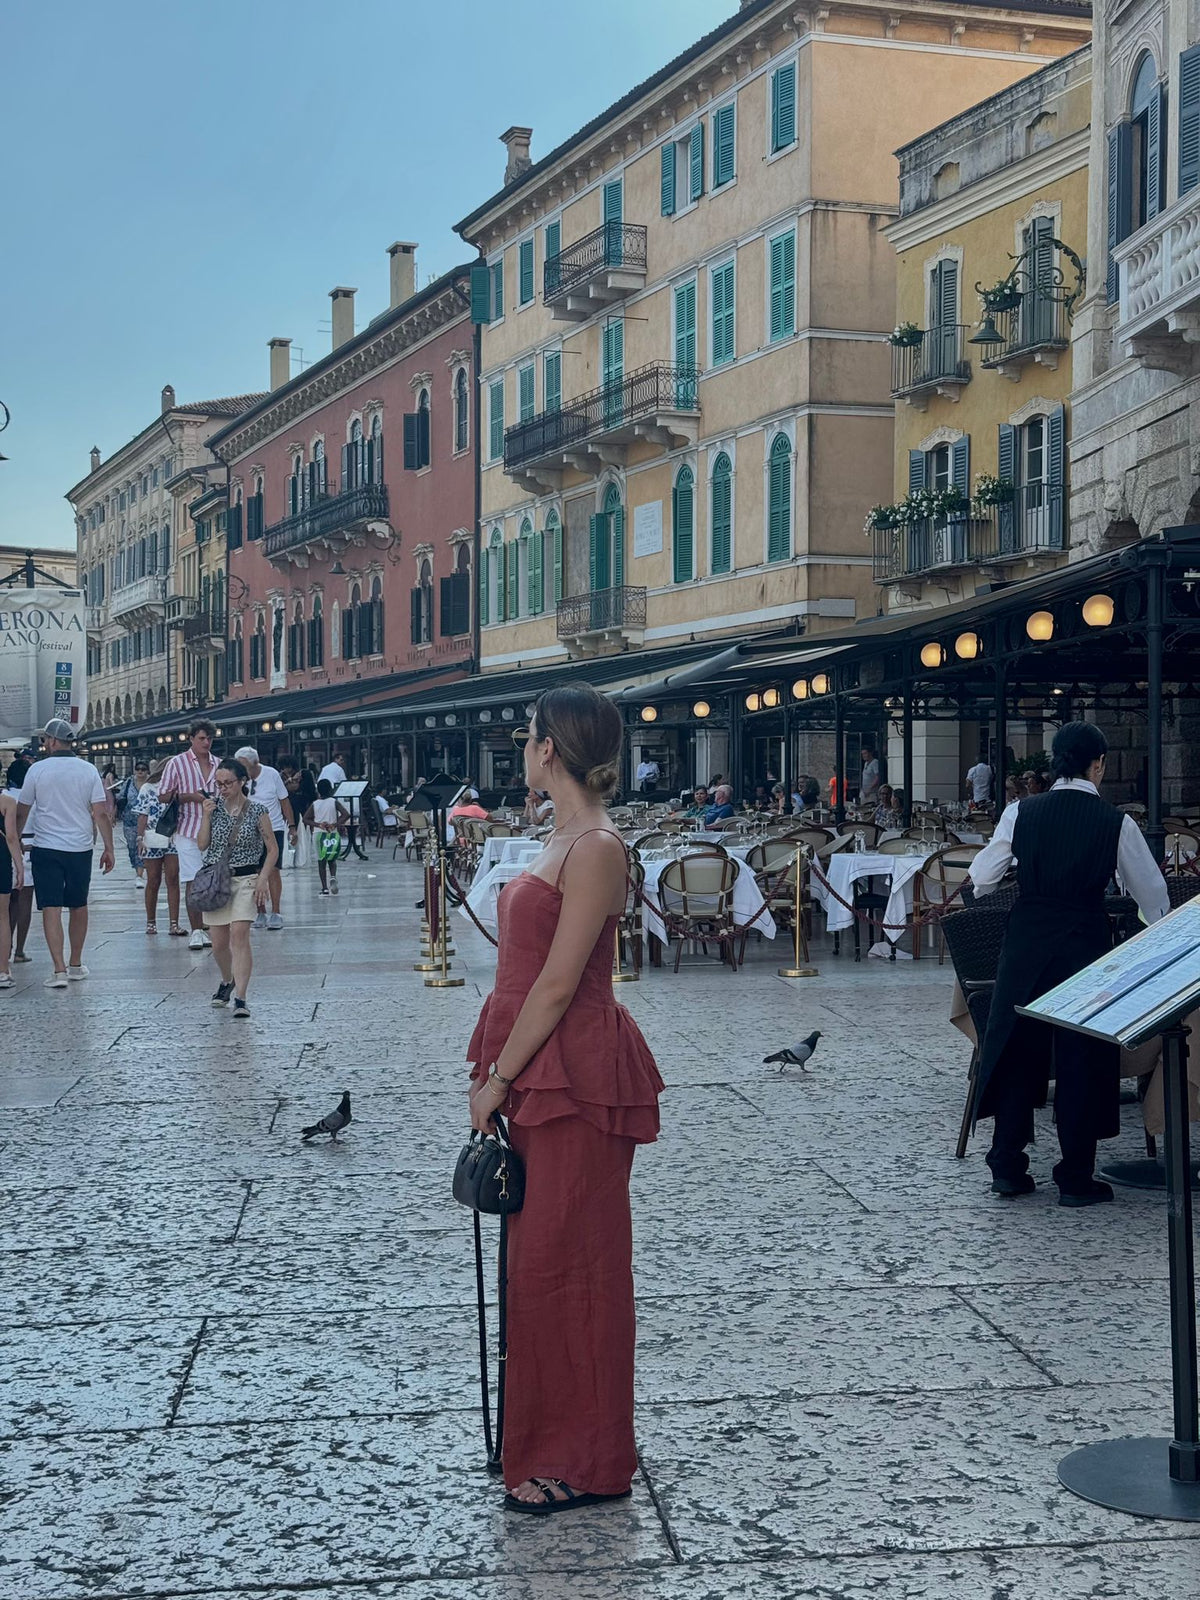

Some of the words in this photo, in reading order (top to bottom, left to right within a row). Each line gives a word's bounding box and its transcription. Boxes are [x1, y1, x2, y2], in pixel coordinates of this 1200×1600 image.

[0, 609, 83, 632] ERONA
[0, 629, 40, 648] ANO
[38, 639, 73, 652] festival
[61, 663, 67, 671] 8
[61, 678, 66, 686] 5
[57, 692, 68, 701] 20
